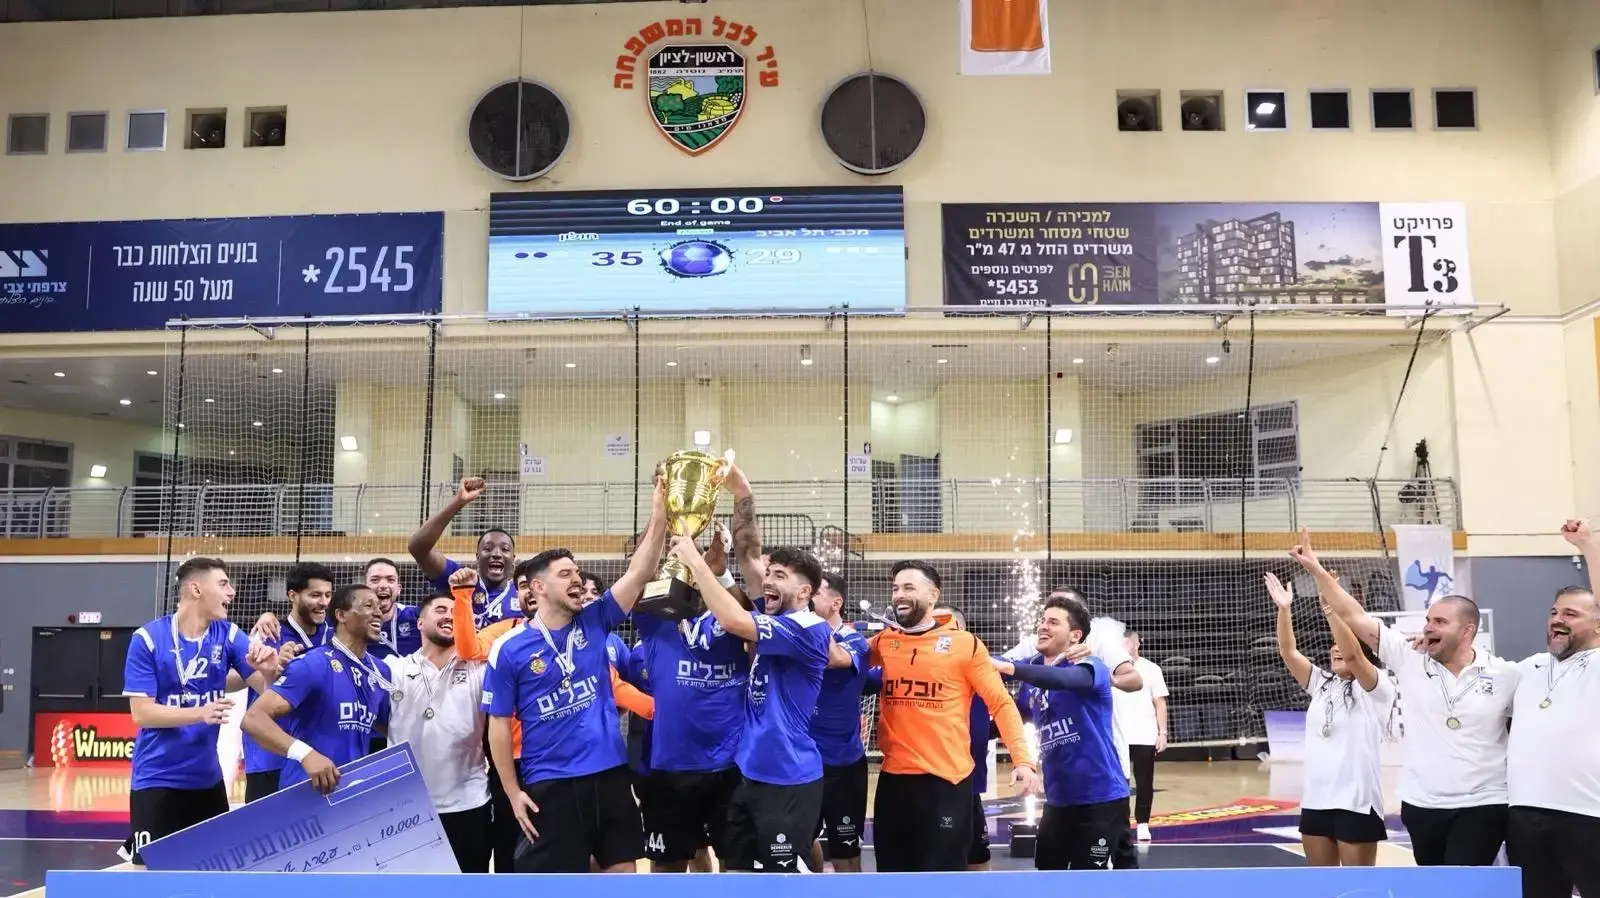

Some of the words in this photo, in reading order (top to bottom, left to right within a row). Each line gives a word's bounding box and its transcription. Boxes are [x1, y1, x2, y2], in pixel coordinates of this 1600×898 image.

[712, 16, 758, 46] לכל
[614, 18, 702, 89] המשפחה
[660, 49, 735, 67] ראשון-לציון
[757, 46, 779, 87] עיר
[986, 211, 1040, 223] השכרה
[1057, 210, 1111, 223] למכירה
[1394, 217, 1453, 233] פרויקט
[756, 229, 797, 237] אביב
[801, 228, 825, 237] תל
[969, 227, 1034, 239] ומשרדים
[1039, 227, 1082, 239] מסחר
[1088, 227, 1129, 239] שטחי
[149, 240, 212, 266] הצלחות
[217, 242, 258, 264] בונים
[998, 243, 1016, 255] 47
[1020, 243, 1032, 255] מ
[1036, 242, 1068, 255] החל
[1073, 243, 1133, 255] משרדים
[113, 246, 144, 267] כבר
[592, 251, 643, 266] 35
[745, 249, 802, 265] 29
[971, 264, 1009, 275] נוספים
[1012, 263, 1053, 275] לפרטים
[4, 283, 24, 293] צבי
[28, 282, 68, 293] צרפתי
[133, 280, 167, 303] שנה
[174, 280, 194, 300] 50
[200, 278, 233, 302] מעל
[537, 675, 598, 714] יובלים
[885, 677, 943, 698] יובלים
